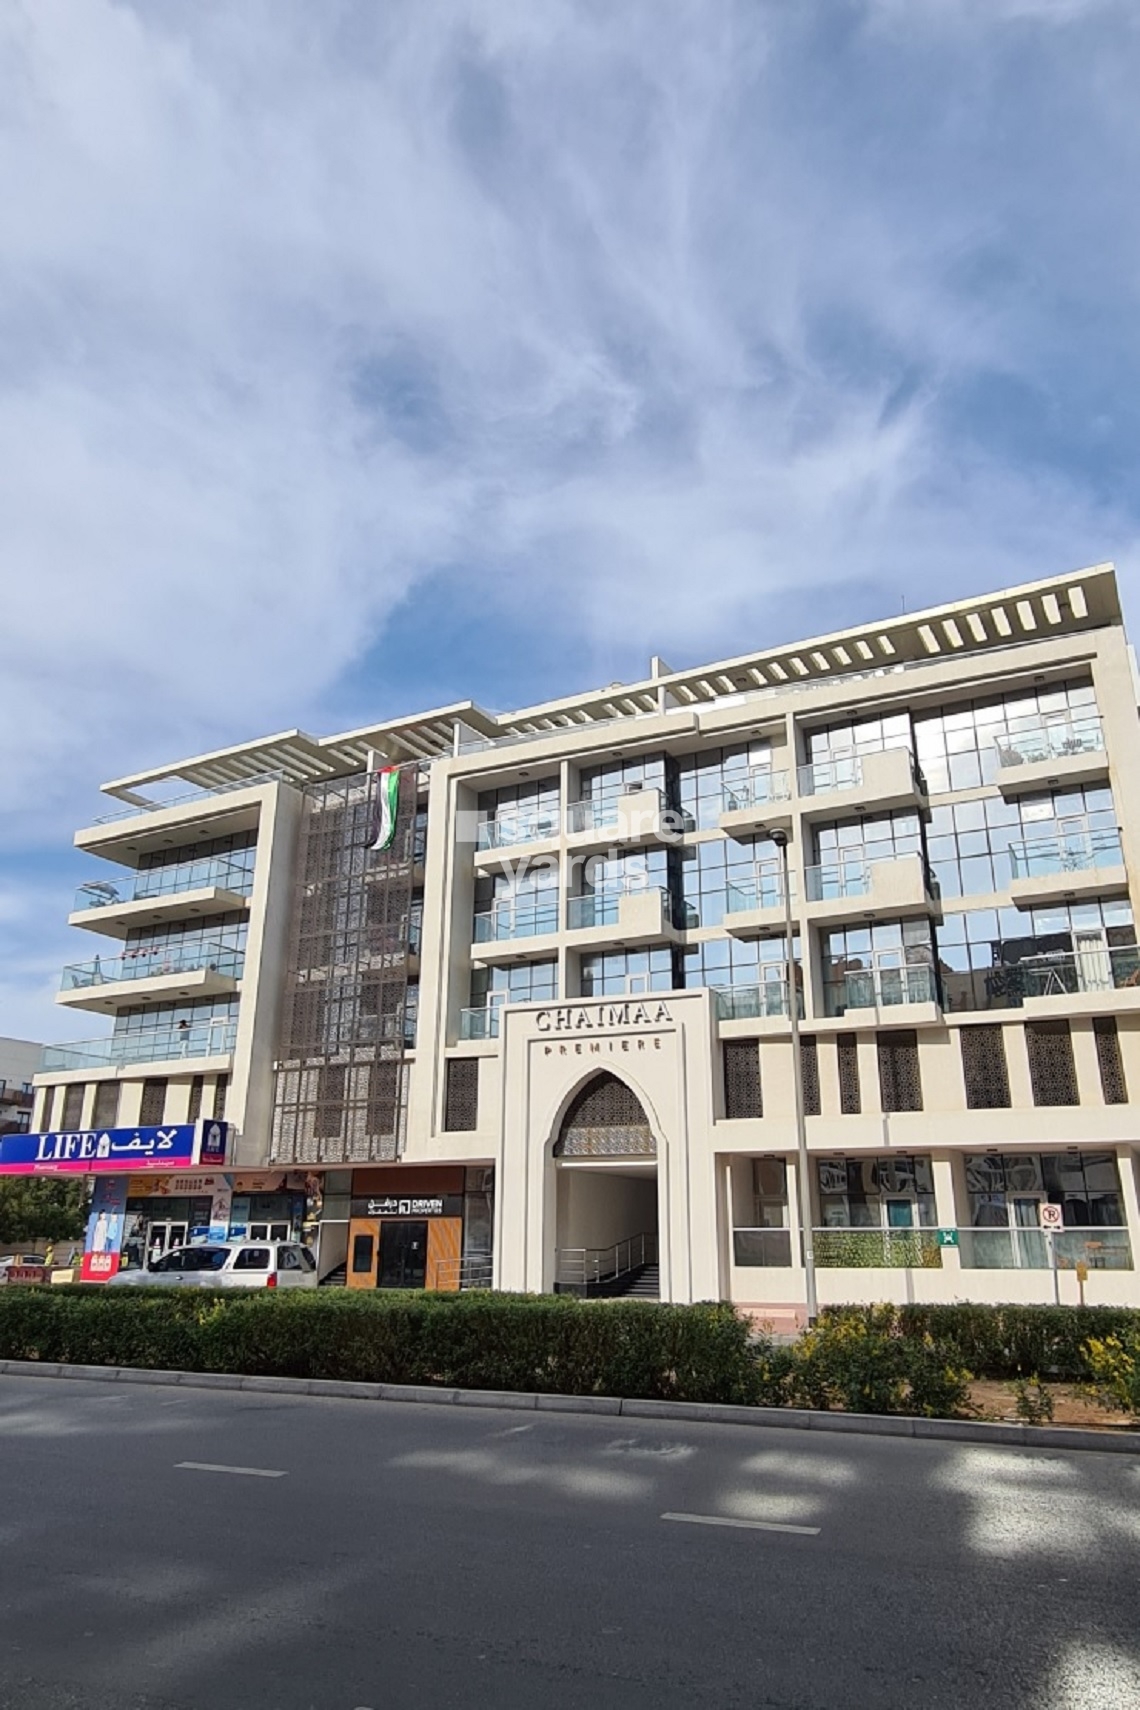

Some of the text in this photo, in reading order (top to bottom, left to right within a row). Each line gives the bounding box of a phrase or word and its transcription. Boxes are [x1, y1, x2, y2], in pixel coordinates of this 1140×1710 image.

[535, 1001, 674, 1032] CHAIMAA
[544, 1038, 662, 1056] PREMIERE
[35, 1132, 98, 1161] LIFE
[111, 1128, 178, 1155] لايف
